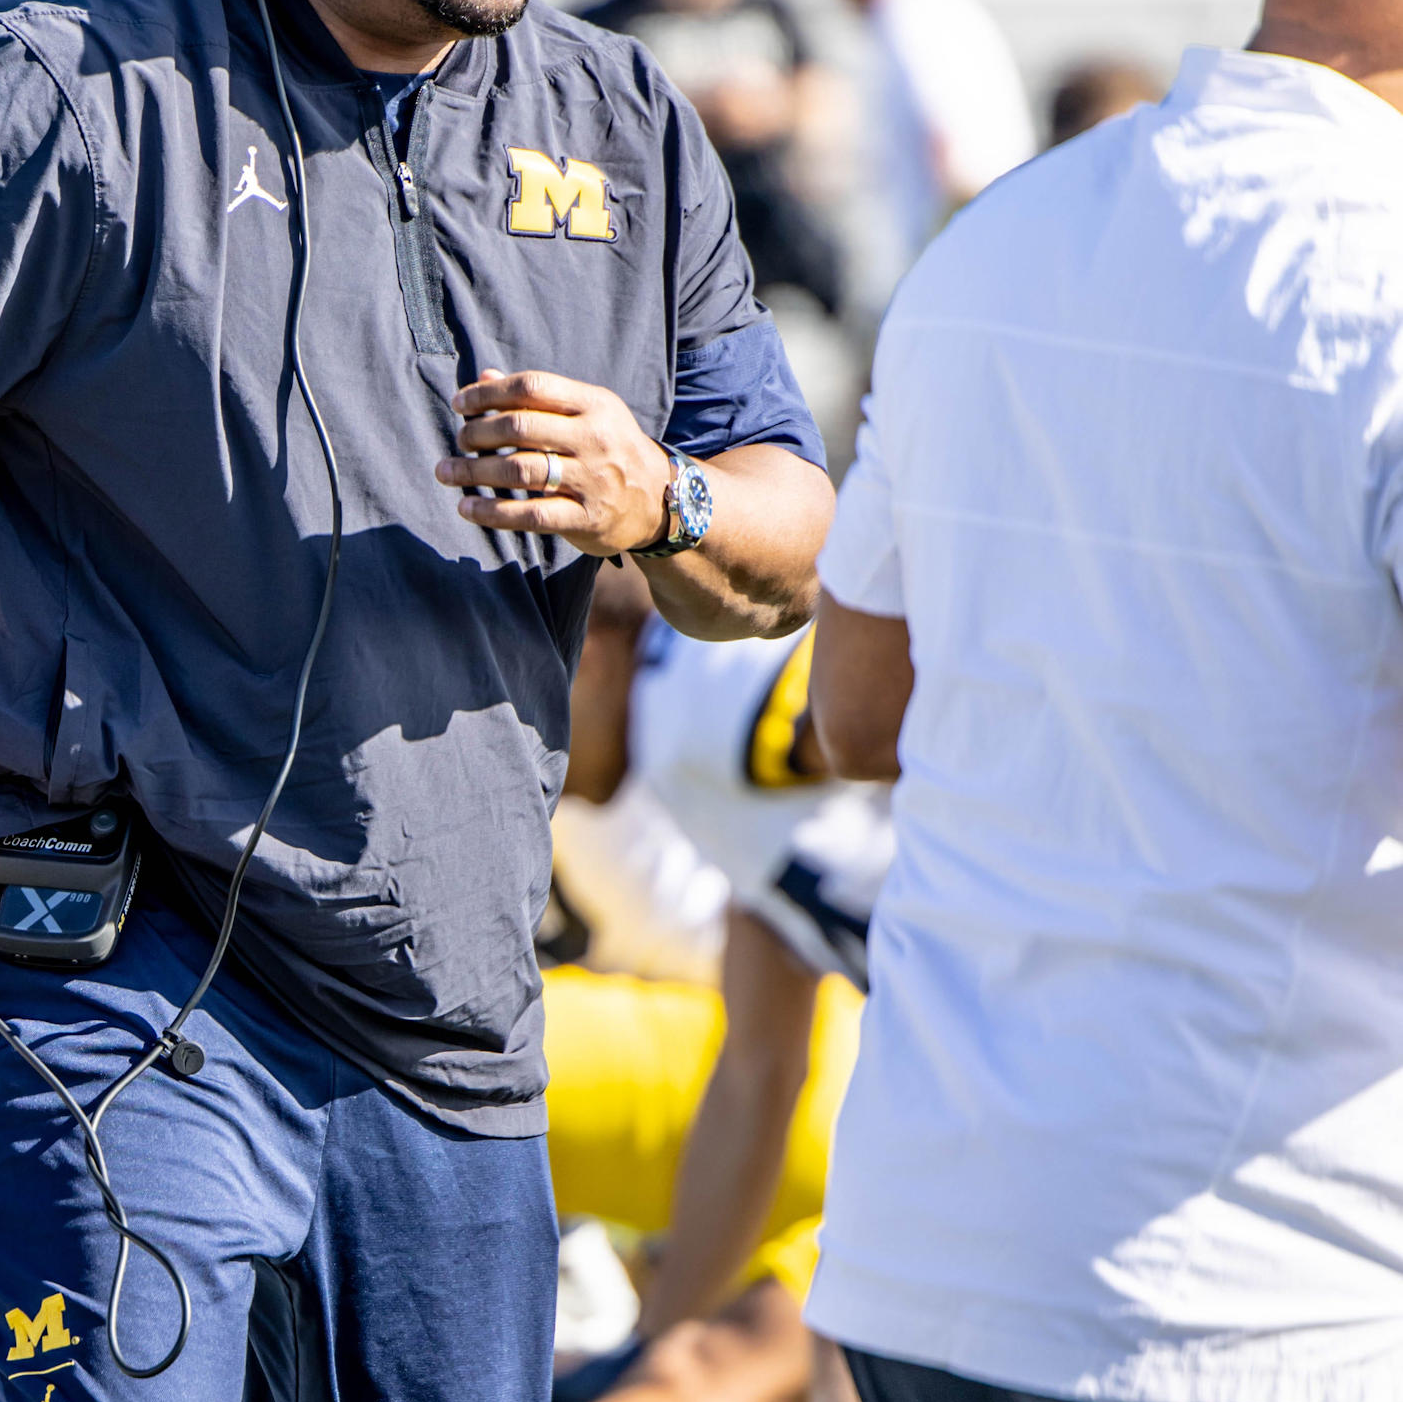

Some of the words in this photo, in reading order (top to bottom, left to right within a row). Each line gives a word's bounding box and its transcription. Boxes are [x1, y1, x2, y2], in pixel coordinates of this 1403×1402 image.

[505, 145, 612, 240] M
[2, 834, 93, 853] CoachComm
[4, 1292, 71, 1361] M
